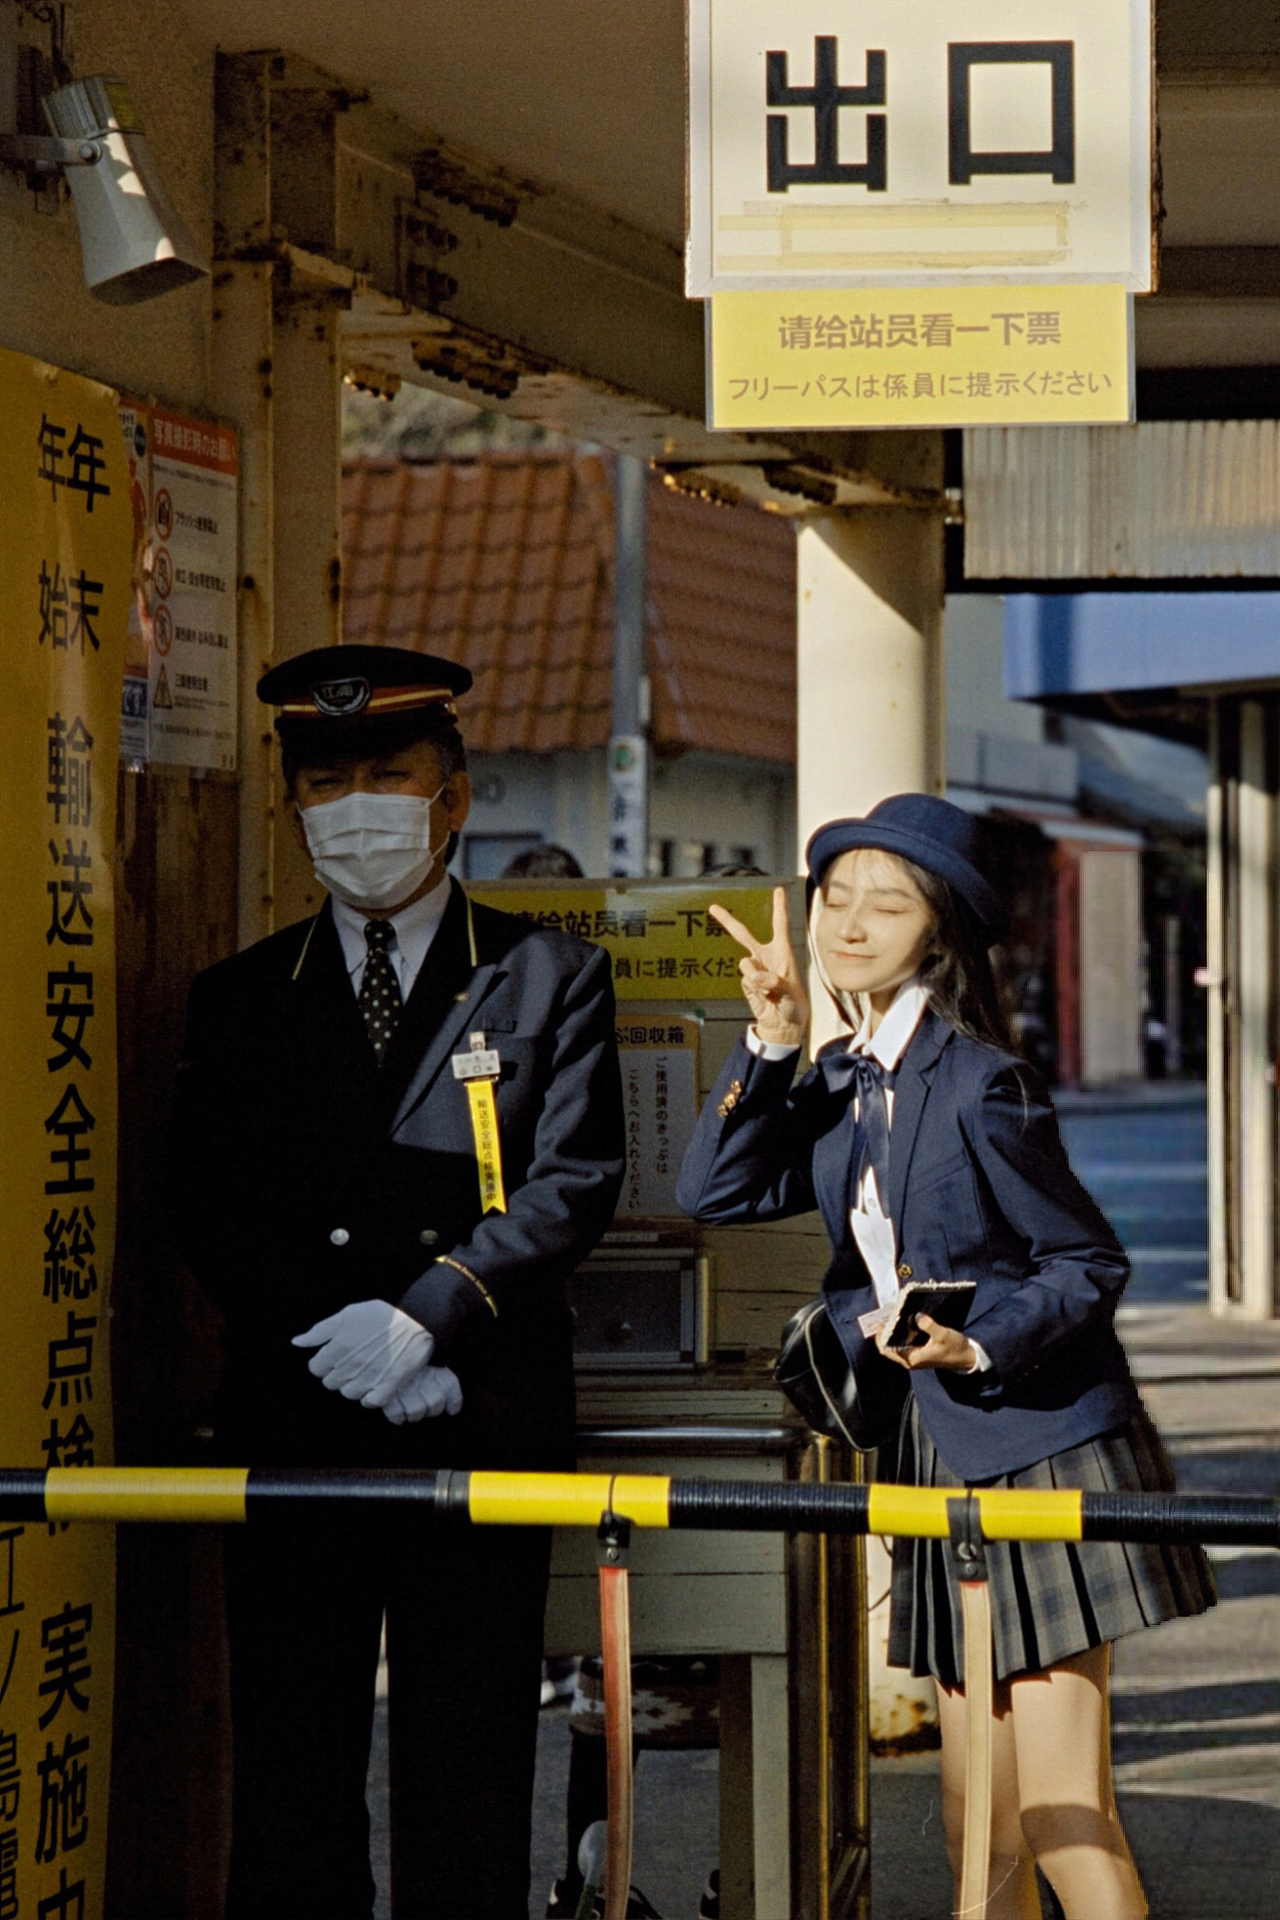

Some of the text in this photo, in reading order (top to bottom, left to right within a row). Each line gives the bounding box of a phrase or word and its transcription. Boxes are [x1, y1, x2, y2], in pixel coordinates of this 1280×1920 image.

[765, 35, 1076, 192] 出口
[778, 311, 1062, 350] 请给站员看一下票
[728, 370, 1112, 400] フリーパスは係員に提示ください
[614, 957, 743, 979] 員に提示くだ
